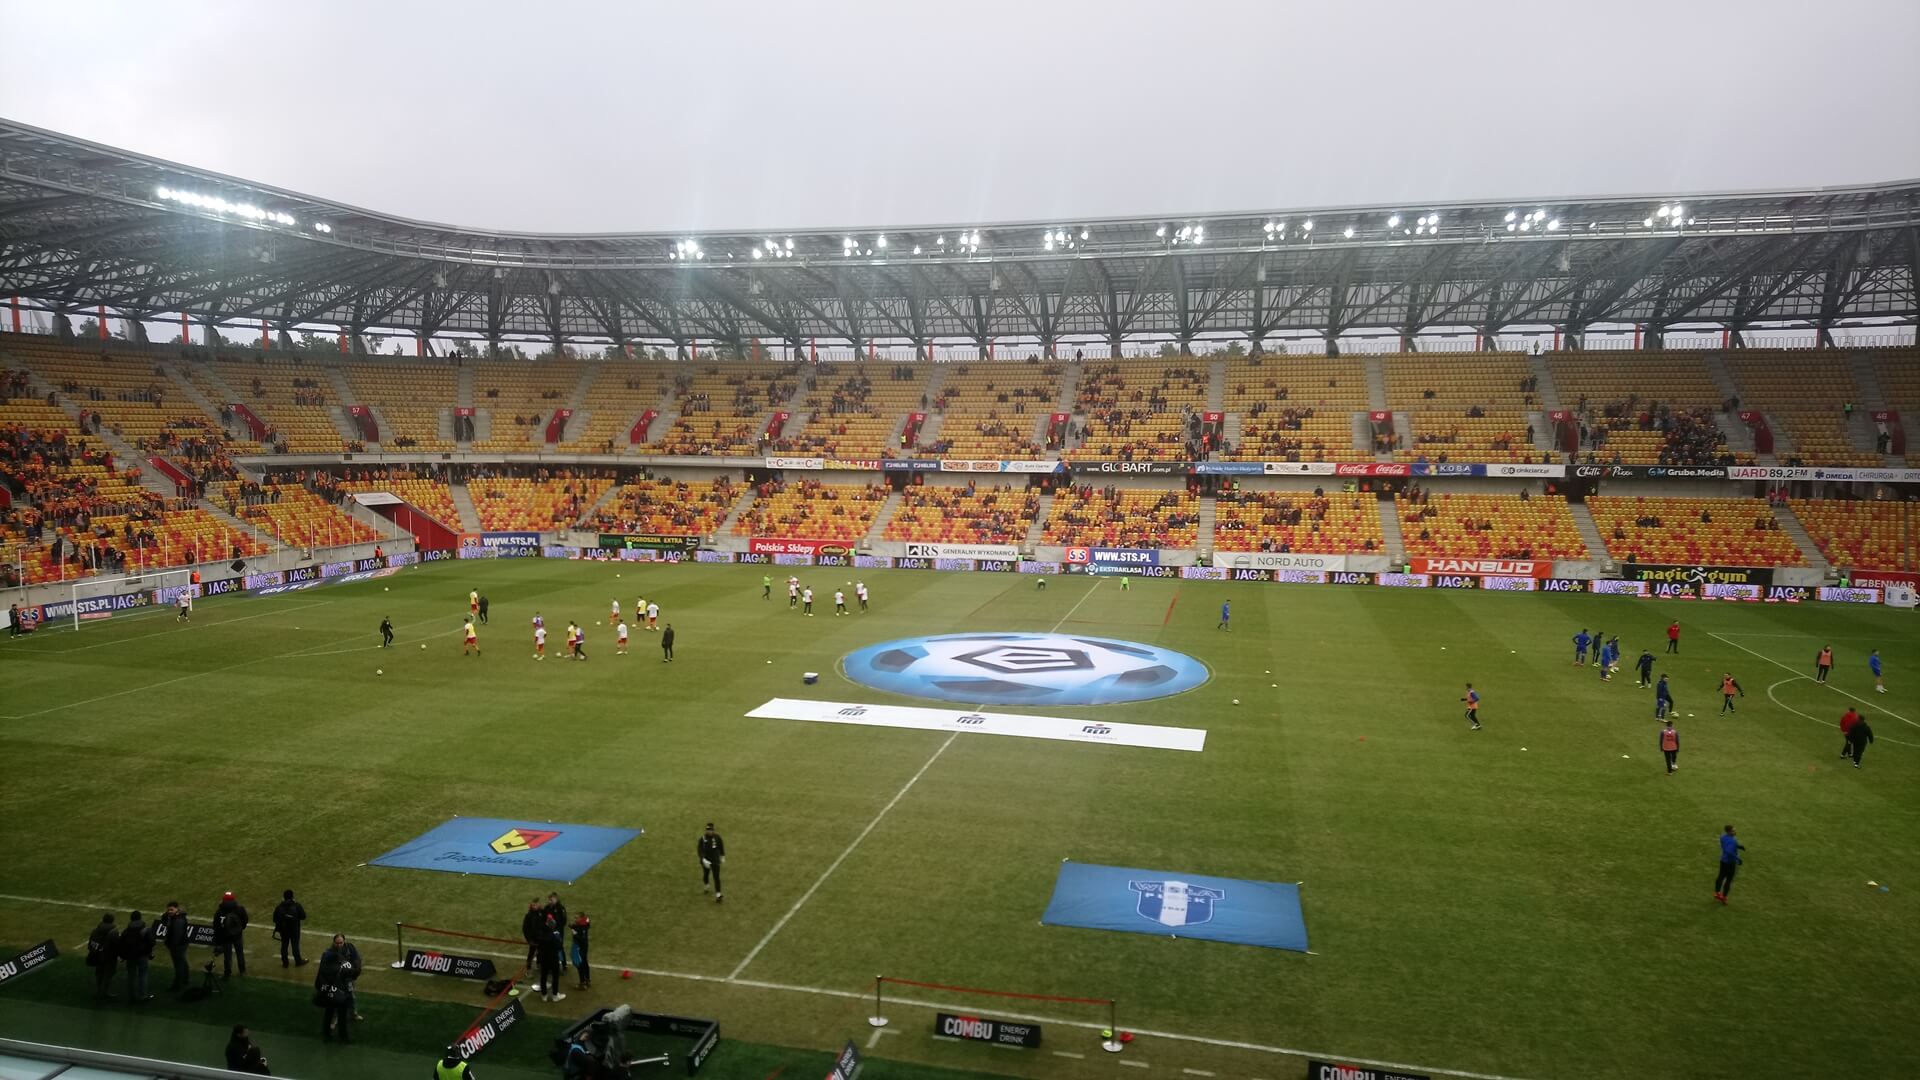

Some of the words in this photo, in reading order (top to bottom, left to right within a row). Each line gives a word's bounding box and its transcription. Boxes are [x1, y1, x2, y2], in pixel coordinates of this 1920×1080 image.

[1339, 464, 1368, 474] Coca-Cola
[1376, 464, 1405, 474] Coca-Cola
[1668, 468, 1724, 476] Grube.Media
[1734, 469, 1767, 478] JARD
[1769, 469, 1793, 478] 89.2
[483, 536, 538, 546] WWW.STS.PL
[755, 542, 785, 552] Polskie
[787, 544, 816, 554] Sklepy
[921, 545, 939, 556] RS
[1094, 551, 1152, 563] WWW.STS.PL
[1257, 557, 1290, 567] NORD
[1293, 558, 1324, 567] AUTO
[1099, 565, 1142, 574] EKSTRAKLASA
[1427, 560, 1535, 573] HANBUD
[1707, 571, 1747, 584] gym
[1867, 579, 1916, 589] BENMAR
[45, 599, 112, 618] WWWSTS.PL
[20, 945, 47, 962] ENERGY
[23, 955, 46, 969] DRINK
[411, 953, 452, 973] COMBU
[456, 959, 482, 968] ENERGY
[455, 967, 475, 976] DRINK
[494, 1005, 516, 1024] ENERGY
[498, 1016, 516, 1032] DRINK
[944, 1017, 993, 1039] COMBU
[1000, 1025, 1031, 1035] ENERGY
[459, 1023, 496, 1059] COMBU
[999, 1034, 1024, 1043] DRINK
